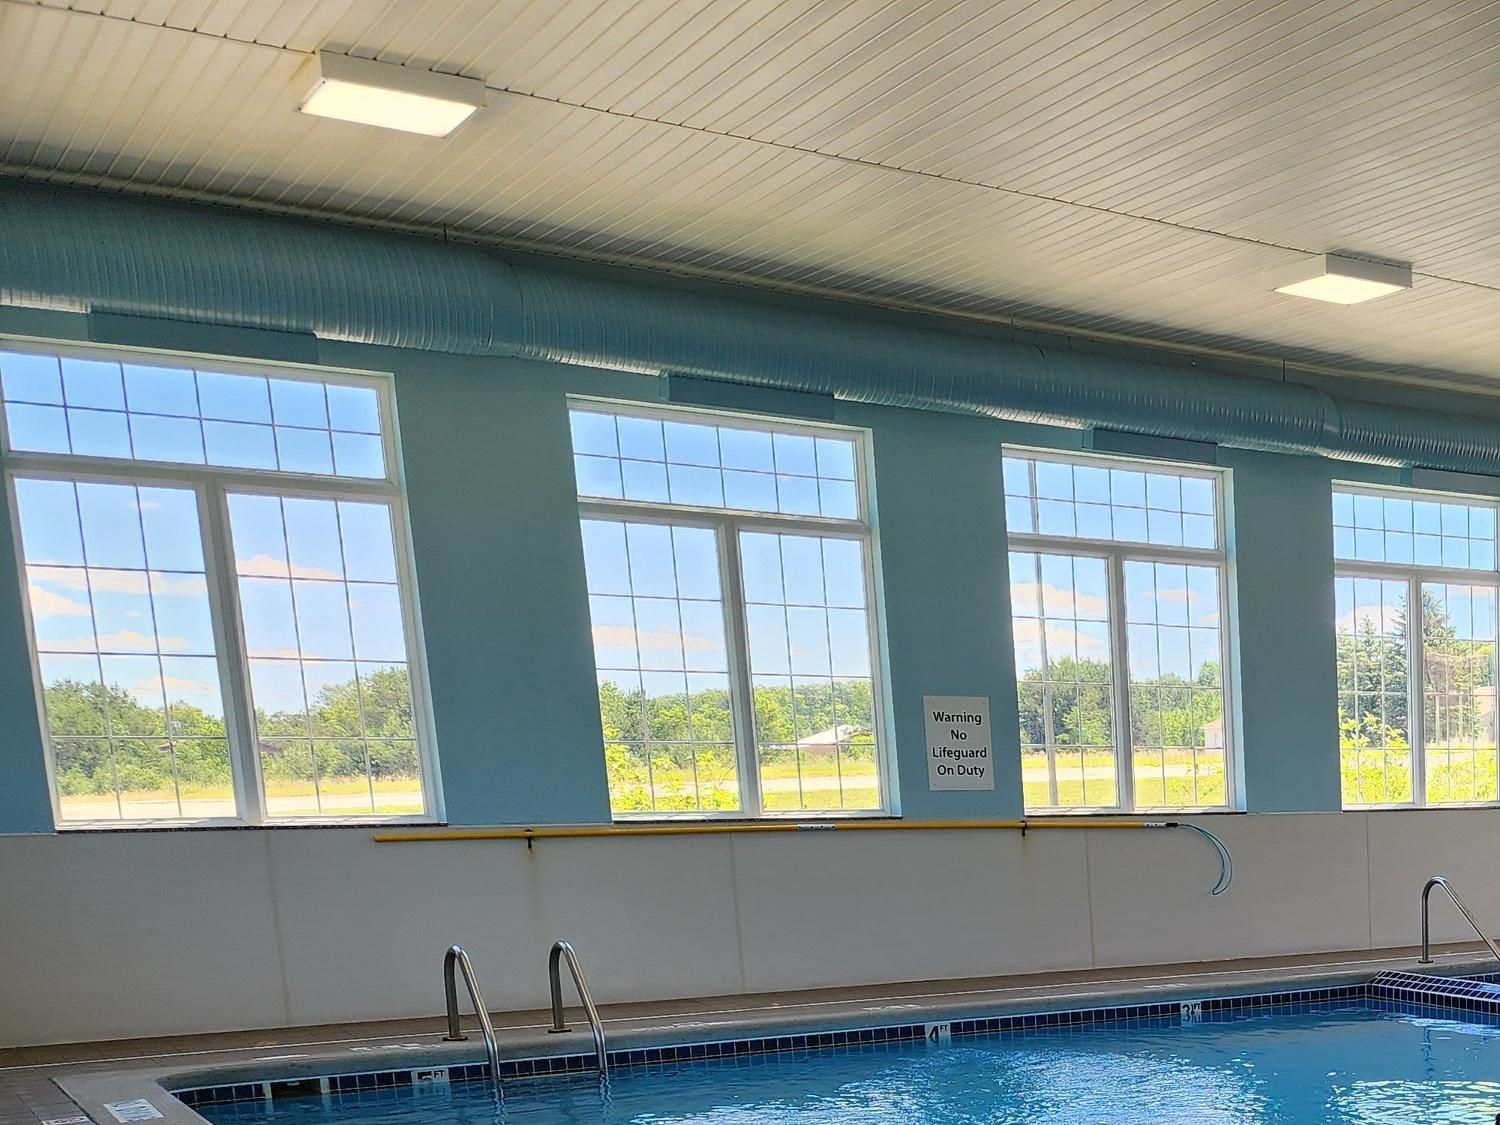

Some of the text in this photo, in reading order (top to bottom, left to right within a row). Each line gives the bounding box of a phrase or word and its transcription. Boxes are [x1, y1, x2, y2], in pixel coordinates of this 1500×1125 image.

[932, 711, 982, 726] Warning
[950, 729, 968, 740] No
[932, 746, 987, 761] Lifeguard
[937, 764, 985, 778] On Duty
[940, 1024, 948, 1032] FT
[433, 1069, 445, 1078] FT
